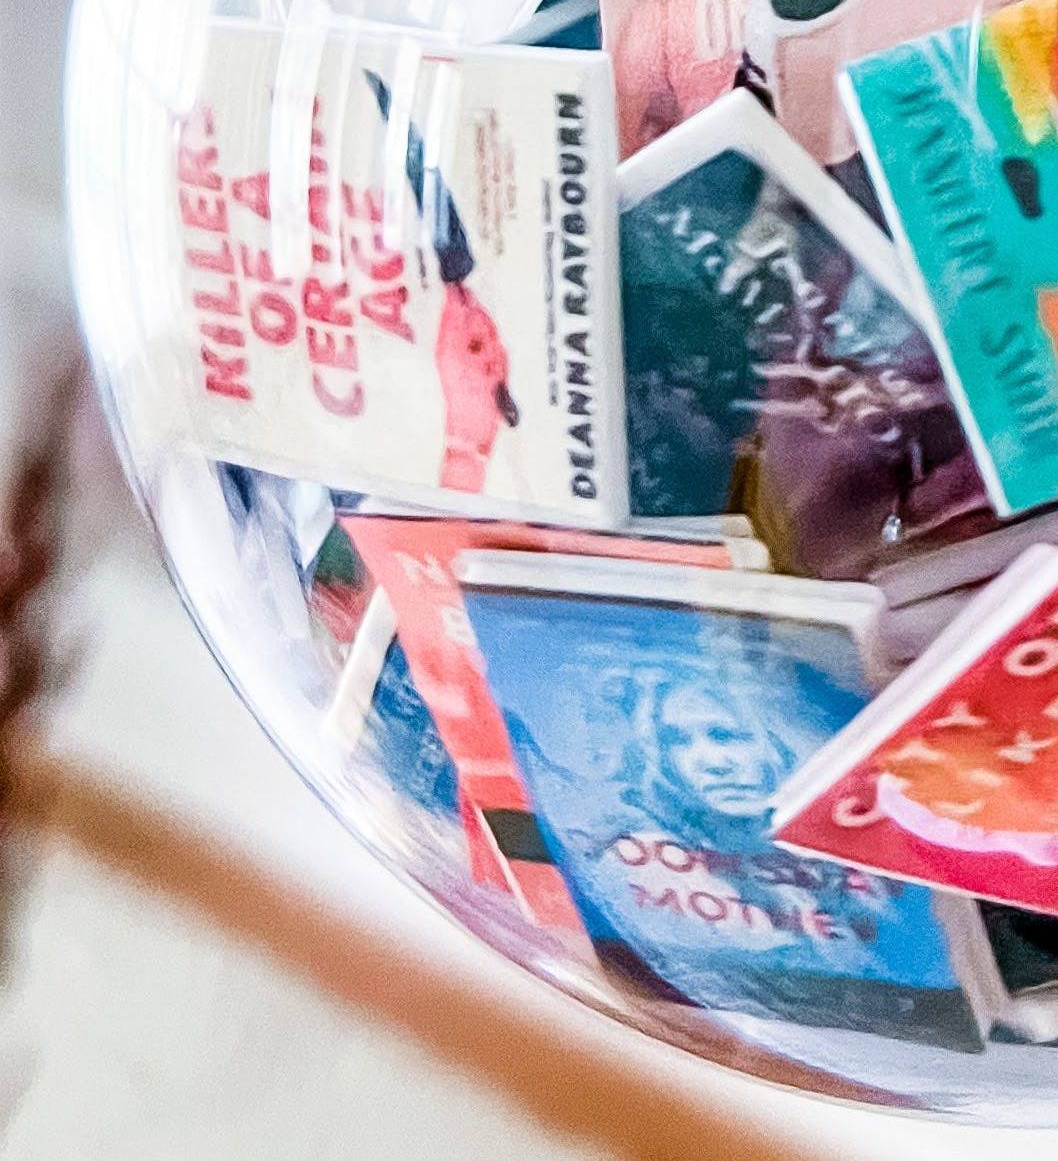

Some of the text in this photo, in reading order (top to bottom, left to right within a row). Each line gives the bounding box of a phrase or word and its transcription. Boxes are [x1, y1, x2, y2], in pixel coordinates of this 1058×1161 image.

[233, 171, 297, 347] OF A
[341, 182, 415, 344] AGE
[554, 92, 598, 502] DEANNA RAYBOURN
[832, 700, 986, 826] CTY
